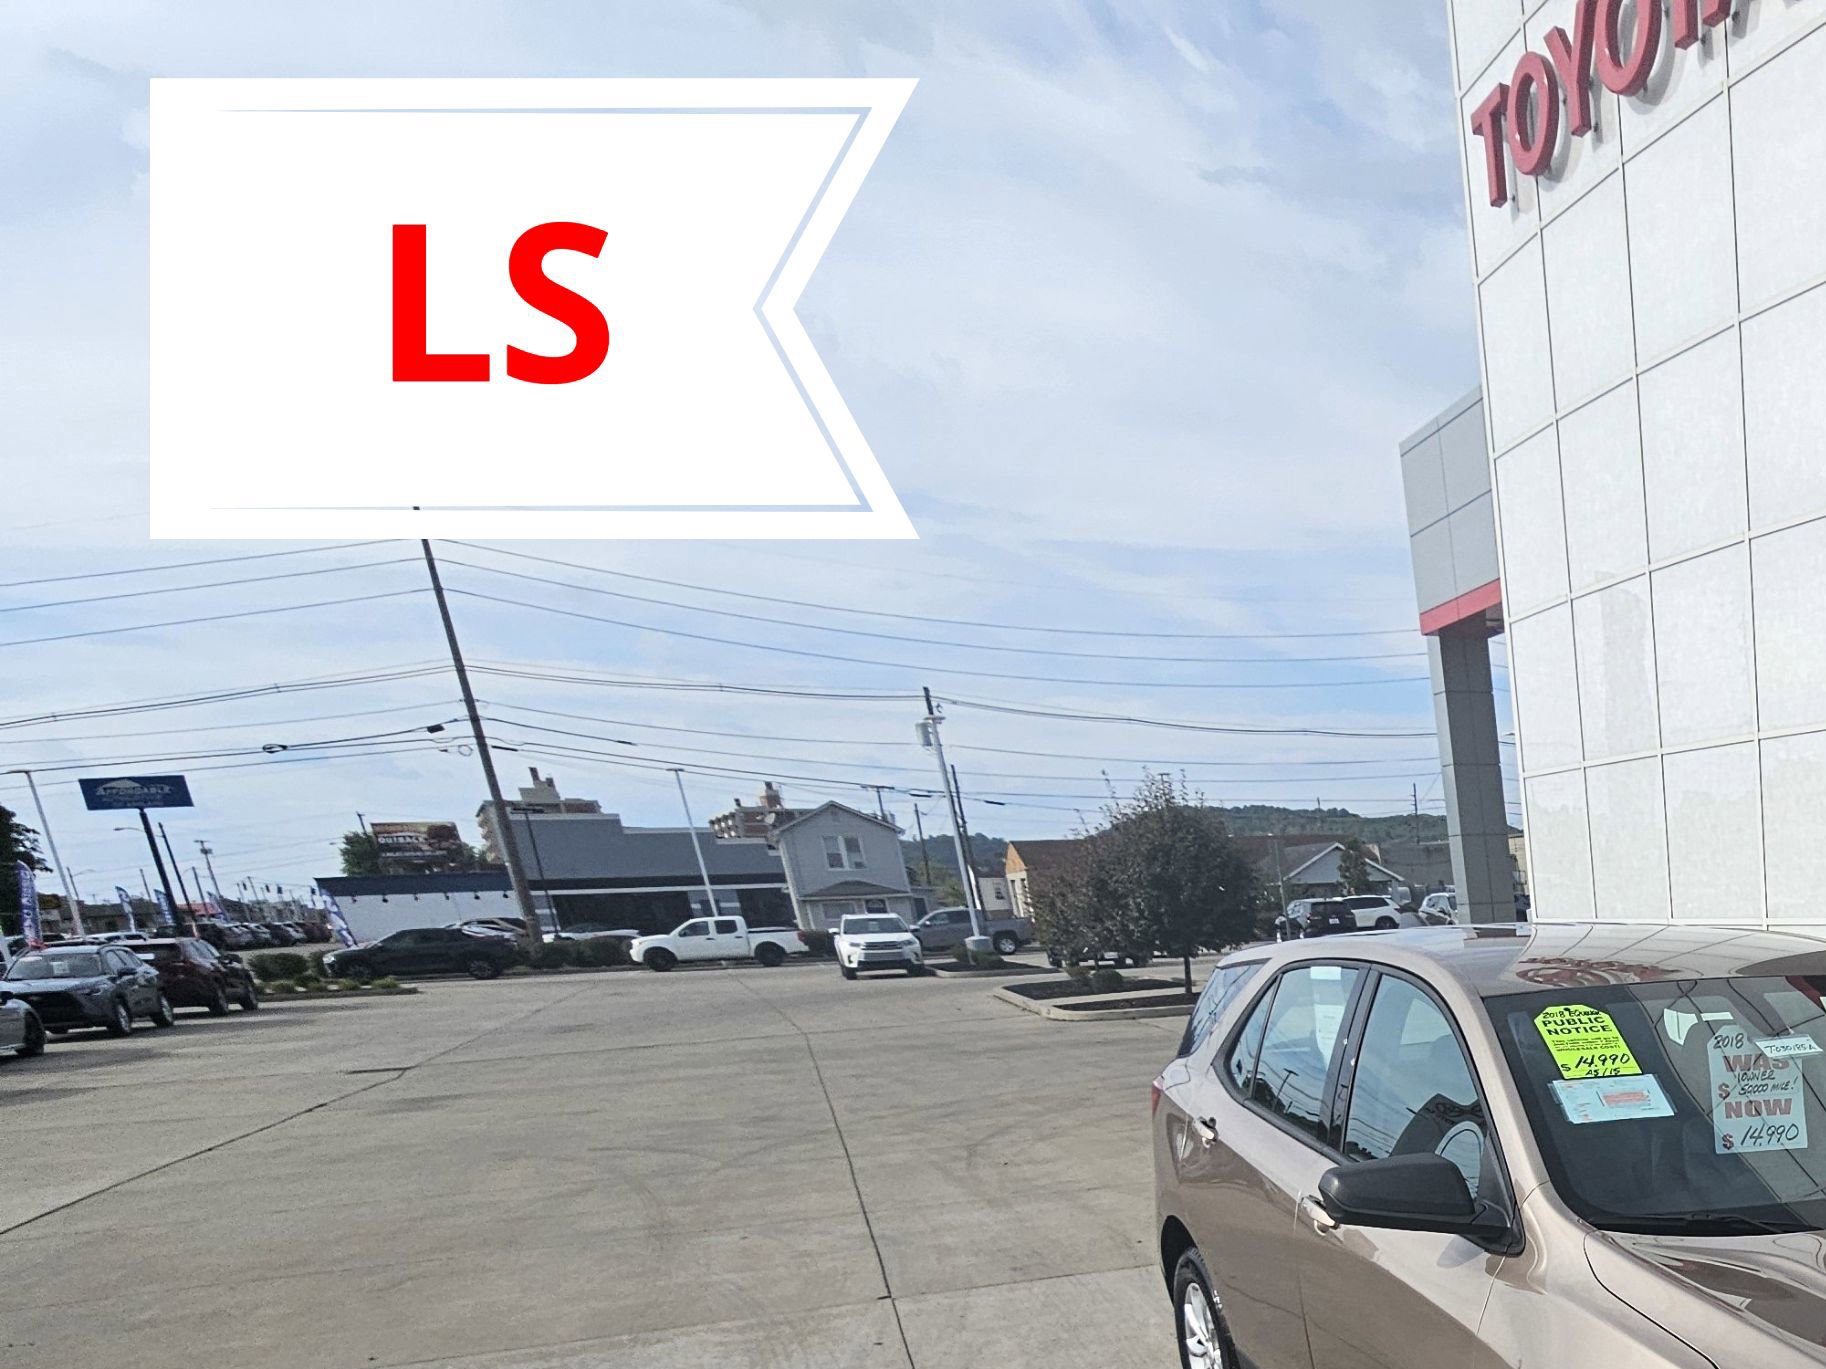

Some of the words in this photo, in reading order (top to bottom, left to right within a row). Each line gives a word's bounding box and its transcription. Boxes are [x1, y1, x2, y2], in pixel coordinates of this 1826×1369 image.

[1471, 0, 1732, 208] TOYO
[1542, 1010, 1566, 1019] 2018
[1542, 1016, 1606, 1028] PUBLIC
[1546, 1025, 1613, 1036] NOTICE
[1713, 1033, 1745, 1050] 2018
[1723, 1054, 1791, 1073] WAS
[1725, 1098, 1793, 1119] NOW
[1721, 1133, 1735, 1150] $
